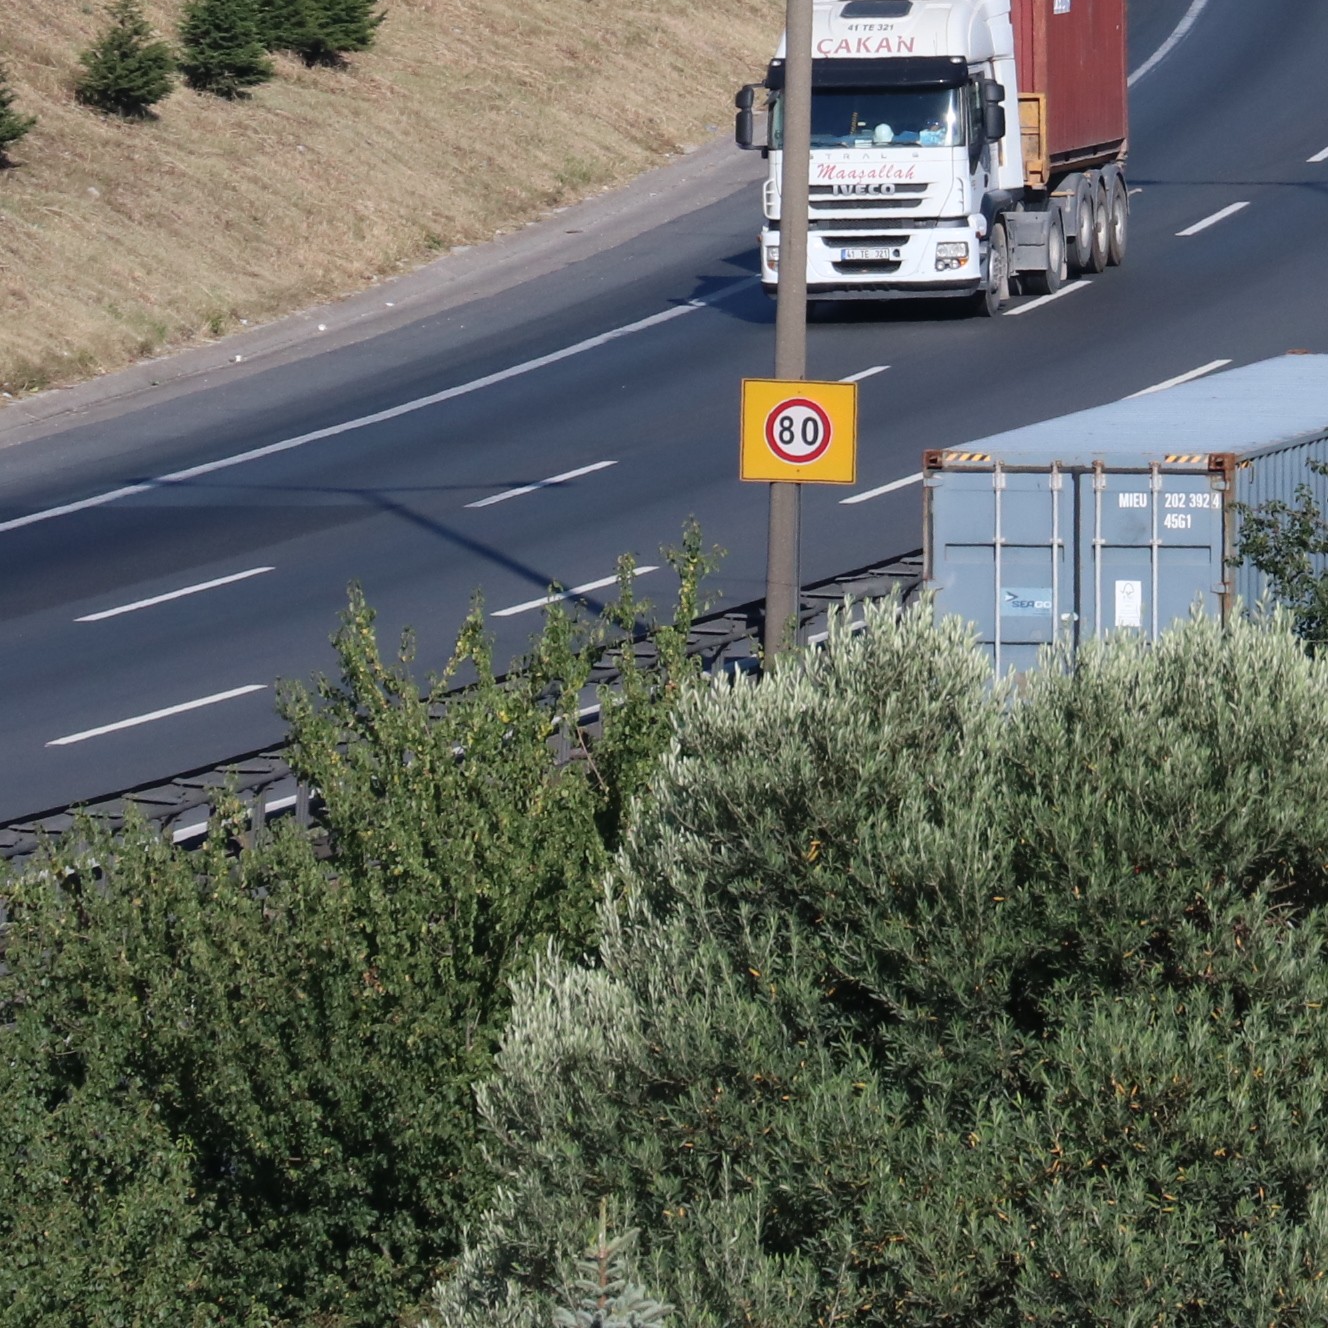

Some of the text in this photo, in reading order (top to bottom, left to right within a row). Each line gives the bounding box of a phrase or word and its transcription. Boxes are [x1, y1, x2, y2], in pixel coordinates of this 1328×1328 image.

[847, 23, 894, 32] 41 TE 321
[816, 35, 916, 58] ÇAKAN
[816, 162, 916, 185] Maaşallah
[832, 183, 896, 197] IVECO
[861, 250, 870, 258] TE
[779, 415, 819, 447] 80
[1119, 493, 1220, 508] MIEU 202 392 4
[1163, 513, 1192, 529] 45G1
